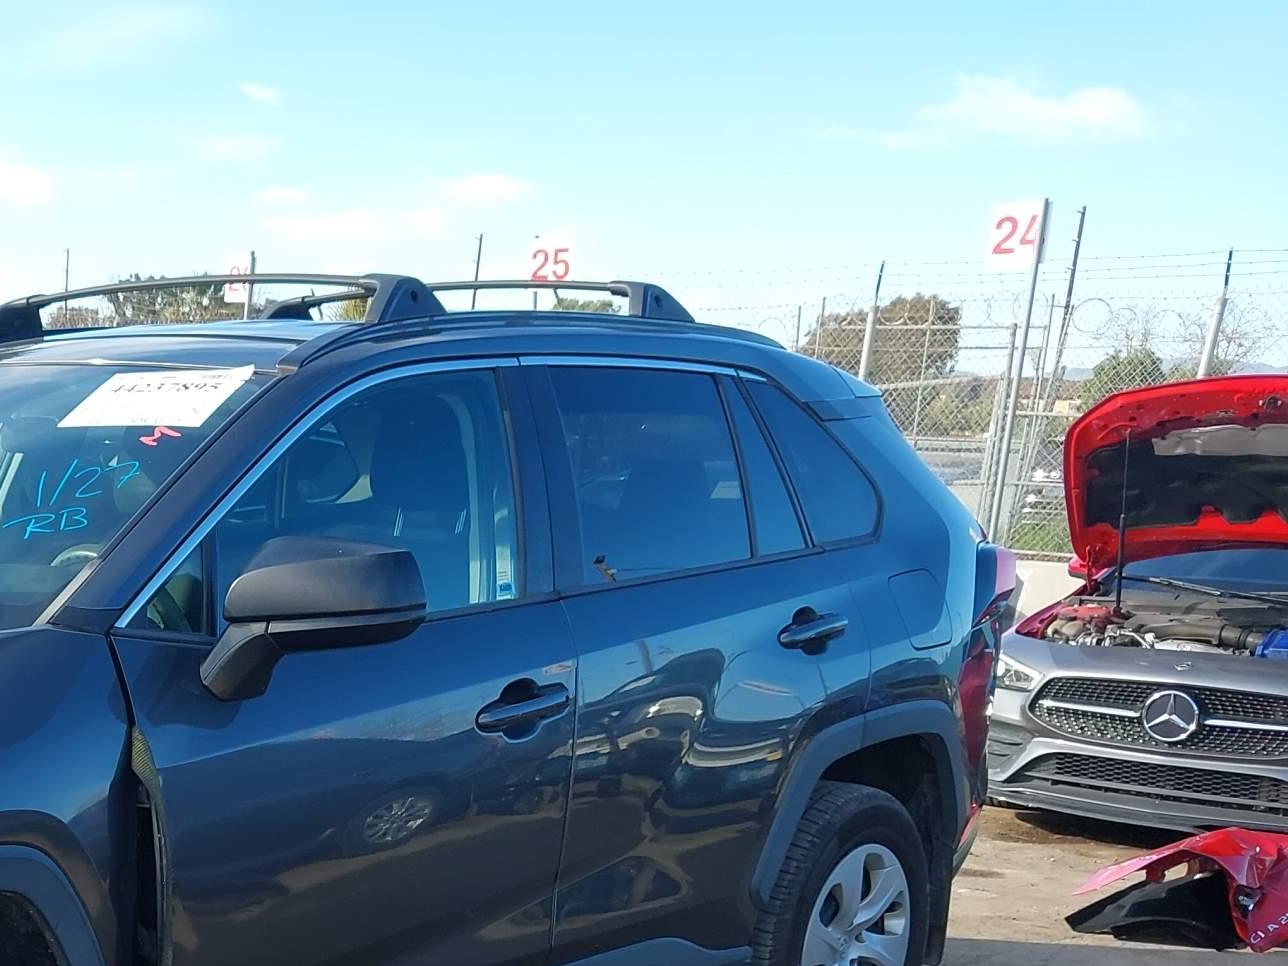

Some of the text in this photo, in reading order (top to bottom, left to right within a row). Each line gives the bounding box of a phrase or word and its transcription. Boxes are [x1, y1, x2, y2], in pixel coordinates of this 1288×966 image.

[992, 214, 1040, 255] 24
[531, 247, 570, 281] 25
[36, 458, 141, 508] 1/27
[1, 507, 89, 540] RB
